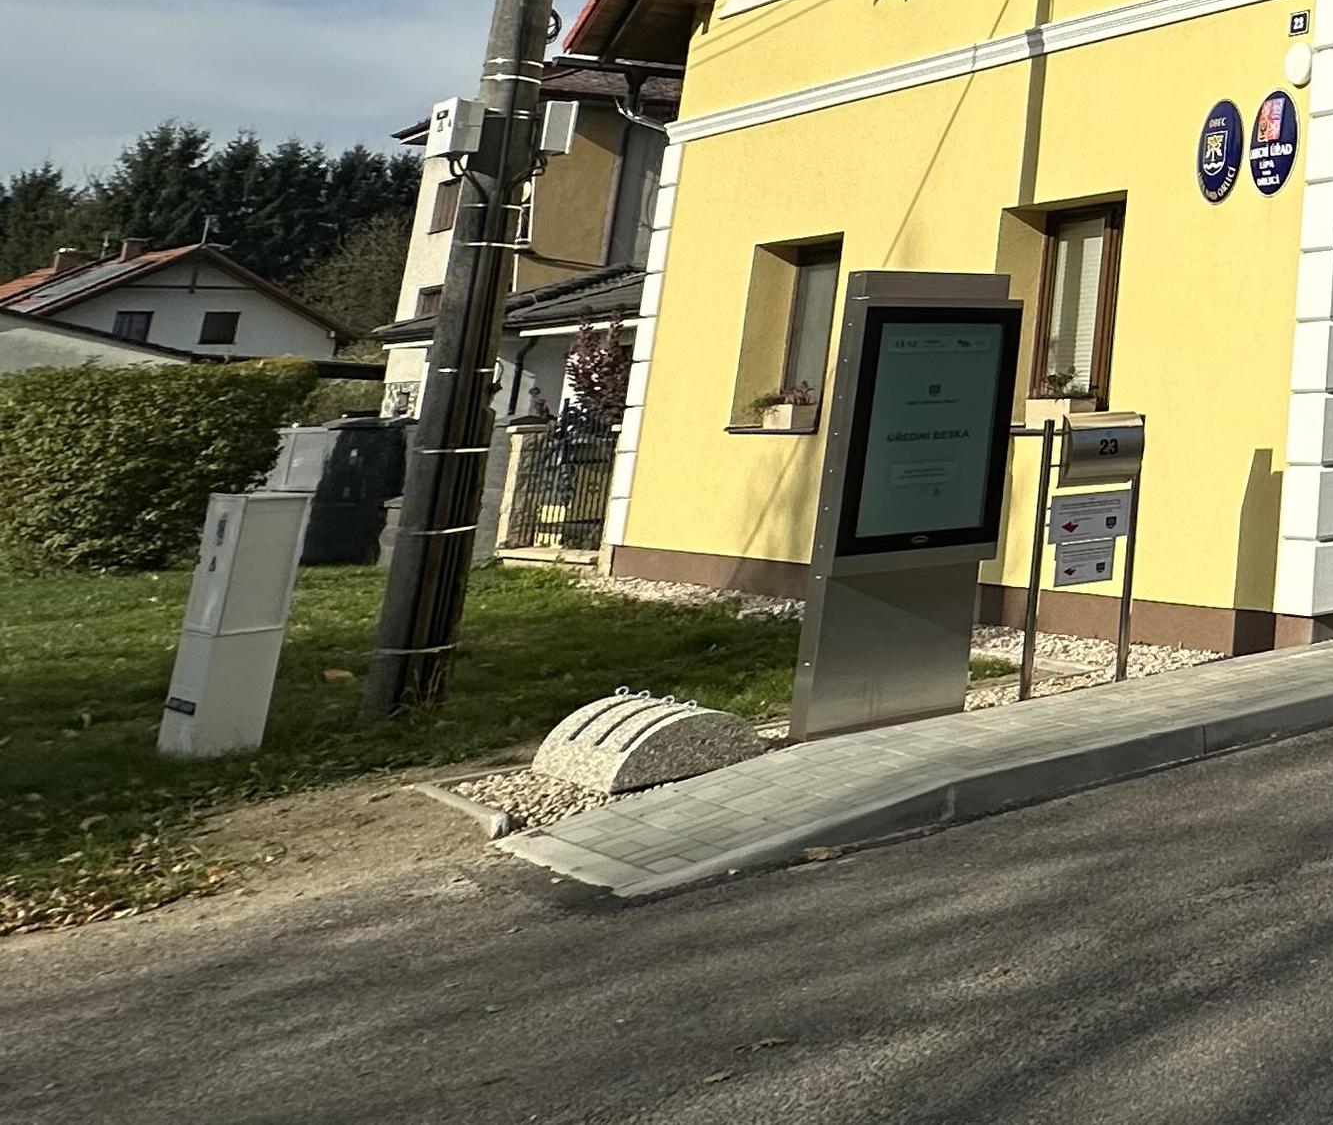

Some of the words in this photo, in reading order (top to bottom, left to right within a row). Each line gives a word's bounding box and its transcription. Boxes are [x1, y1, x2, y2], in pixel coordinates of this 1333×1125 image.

[1293, 16, 1304, 30] 23
[933, 429, 969, 440] DESKA
[1099, 438, 1119, 455] 23
